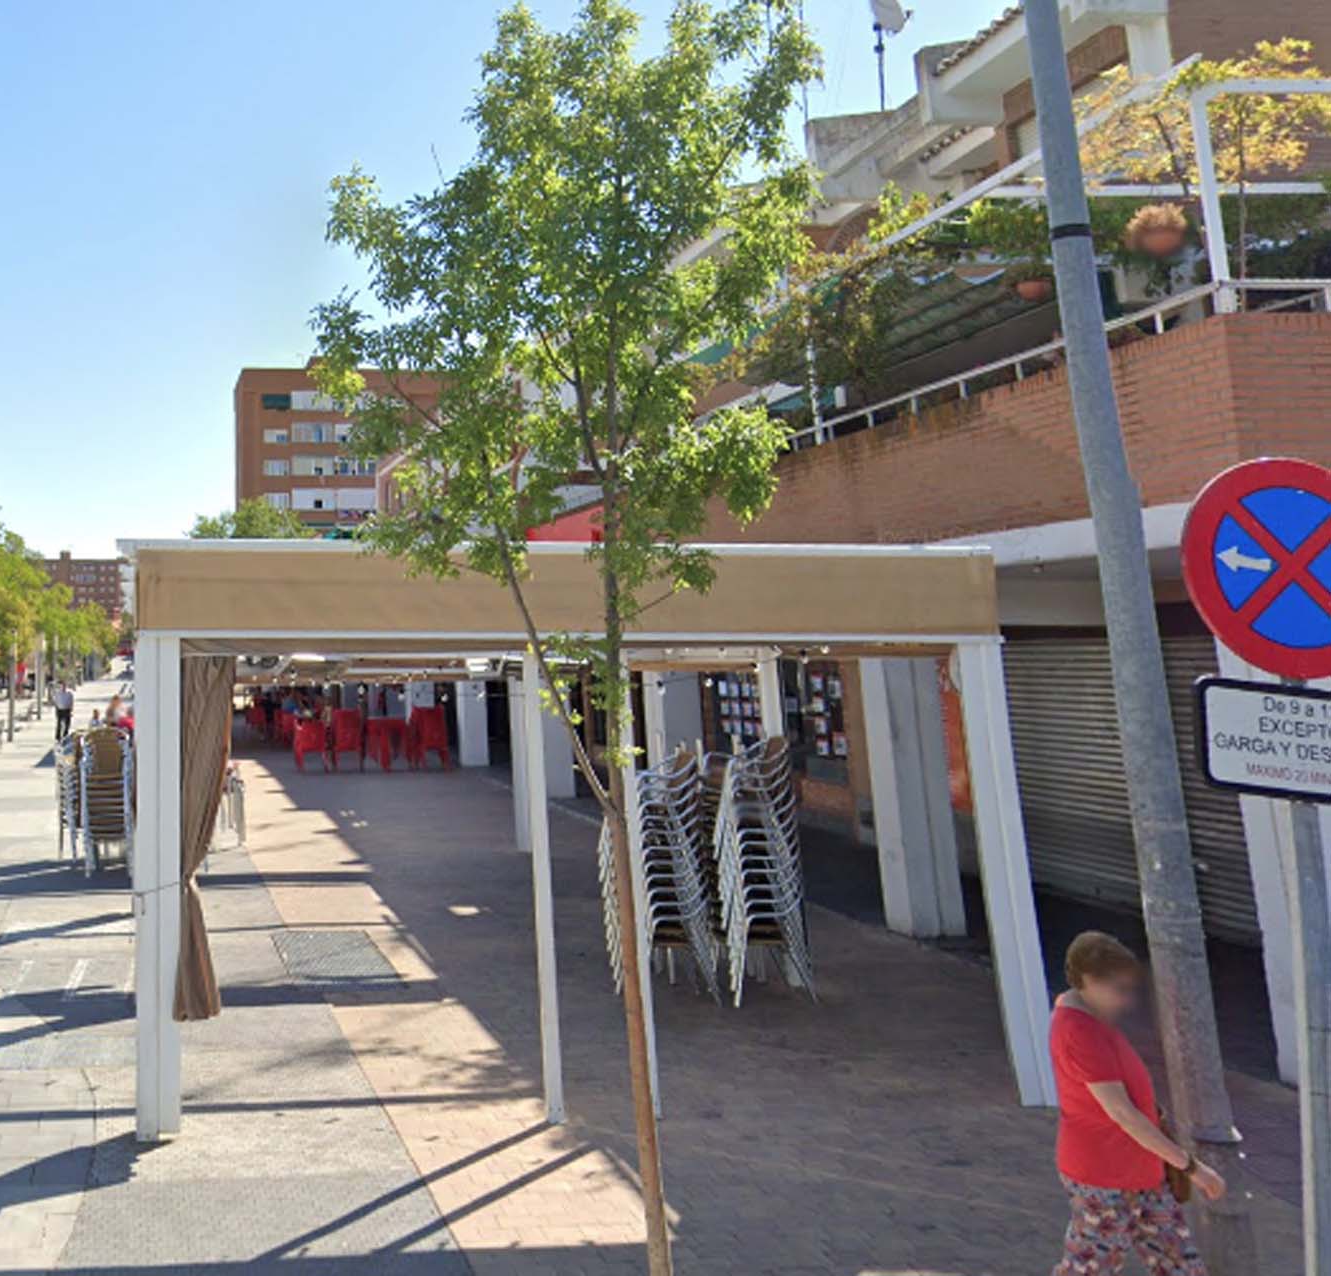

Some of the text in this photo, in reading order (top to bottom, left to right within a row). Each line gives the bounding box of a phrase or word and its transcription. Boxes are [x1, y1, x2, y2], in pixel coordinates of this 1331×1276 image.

[1263, 696, 1285, 714] De
[1290, 700, 1300, 715] 9
[1305, 704, 1314, 718] a
[1259, 716, 1331, 740] EXCEPT
[1279, 741, 1291, 756] Y
